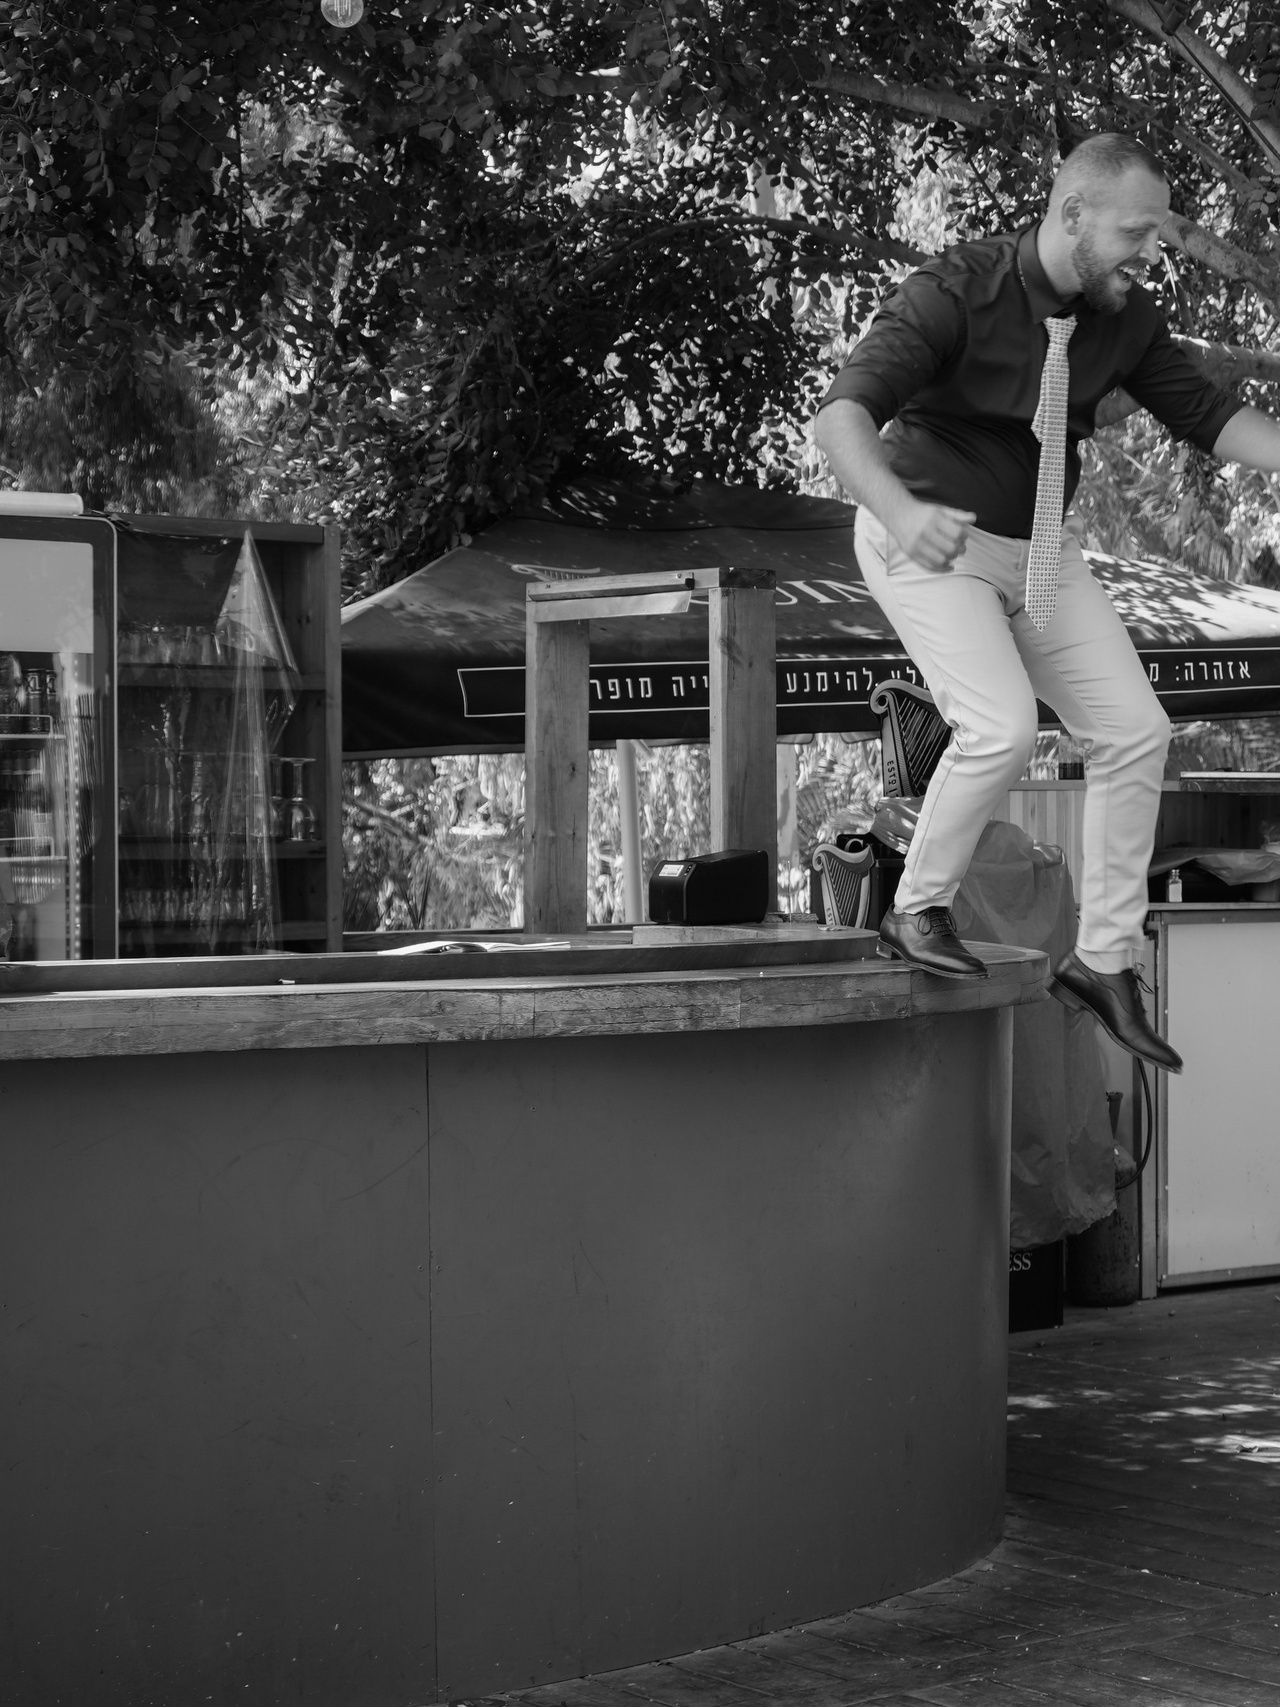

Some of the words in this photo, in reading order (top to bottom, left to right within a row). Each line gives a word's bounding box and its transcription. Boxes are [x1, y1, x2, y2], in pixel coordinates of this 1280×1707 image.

[786, 666, 873, 693] להימנע
[1174, 661, 1252, 682] אזהרה:
[589, 677, 653, 700] מופר
[671, 675, 709, 697] ייה
